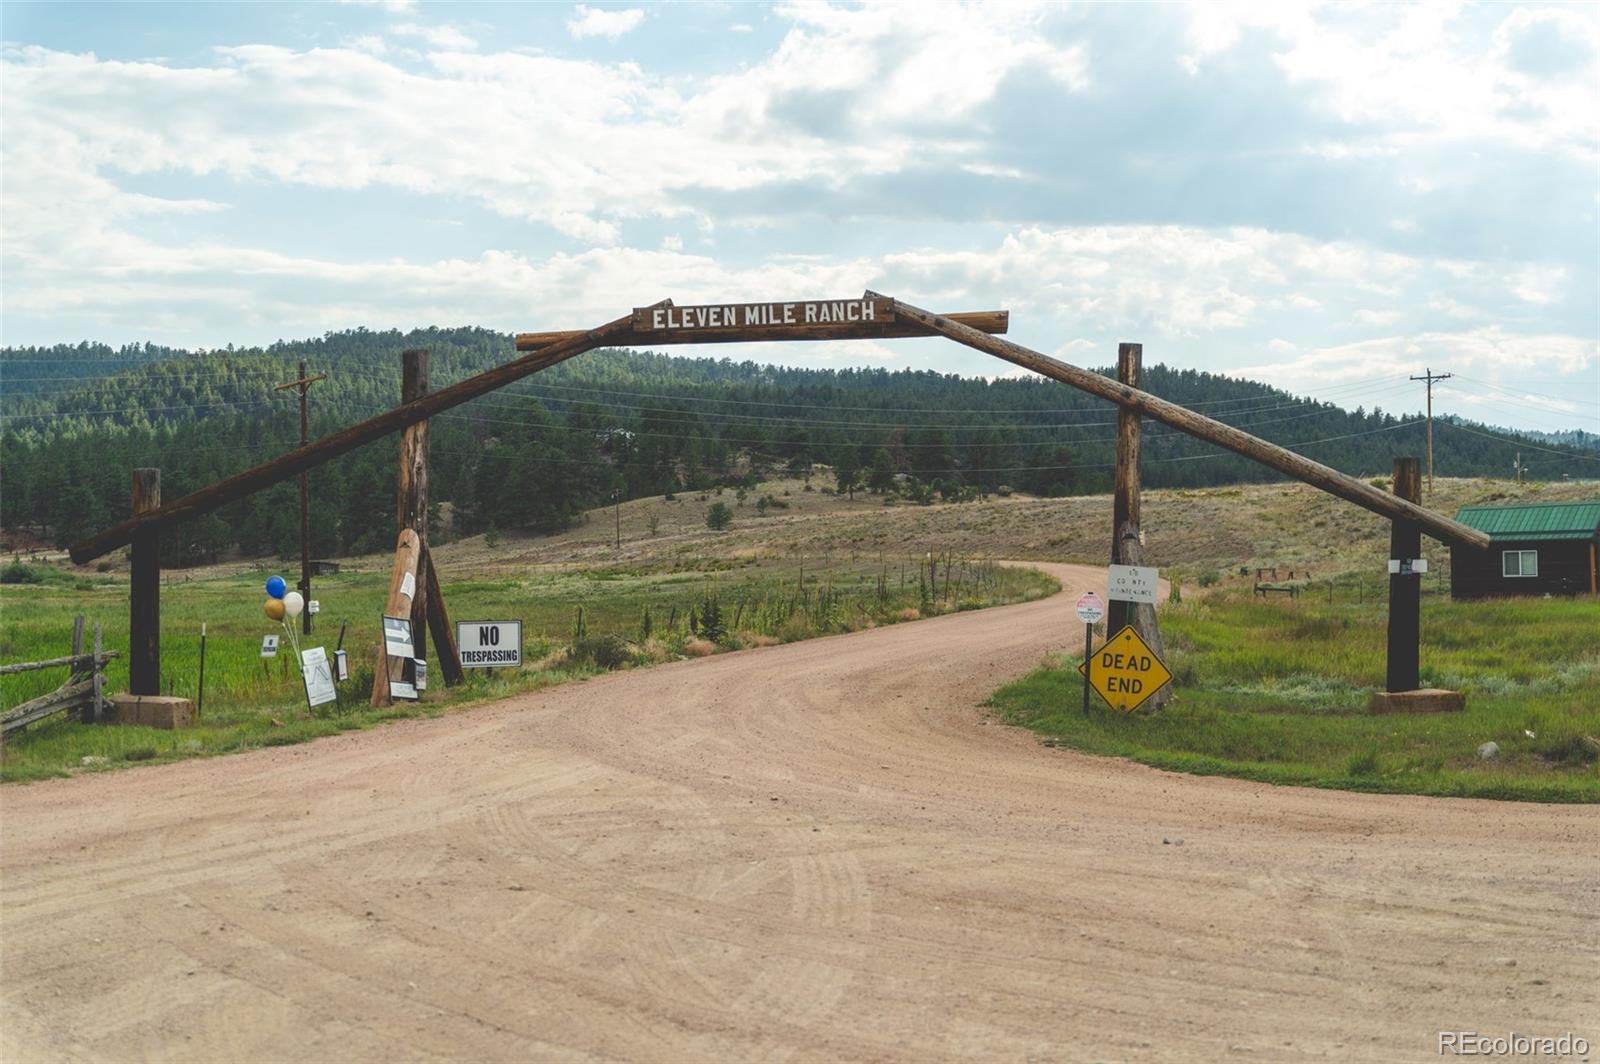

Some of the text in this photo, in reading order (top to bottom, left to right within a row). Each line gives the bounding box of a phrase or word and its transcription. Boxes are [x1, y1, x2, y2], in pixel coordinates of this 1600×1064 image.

[652, 300, 875, 329] ELEVEN MILE RANCH
[1116, 578, 1147, 586] CONTY
[1110, 587, 1152, 597] NTENNCE
[479, 625, 500, 646] NO
[461, 649, 518, 663] TRESPASSING
[1102, 653, 1151, 672] DEAD
[1107, 676, 1143, 695] END
